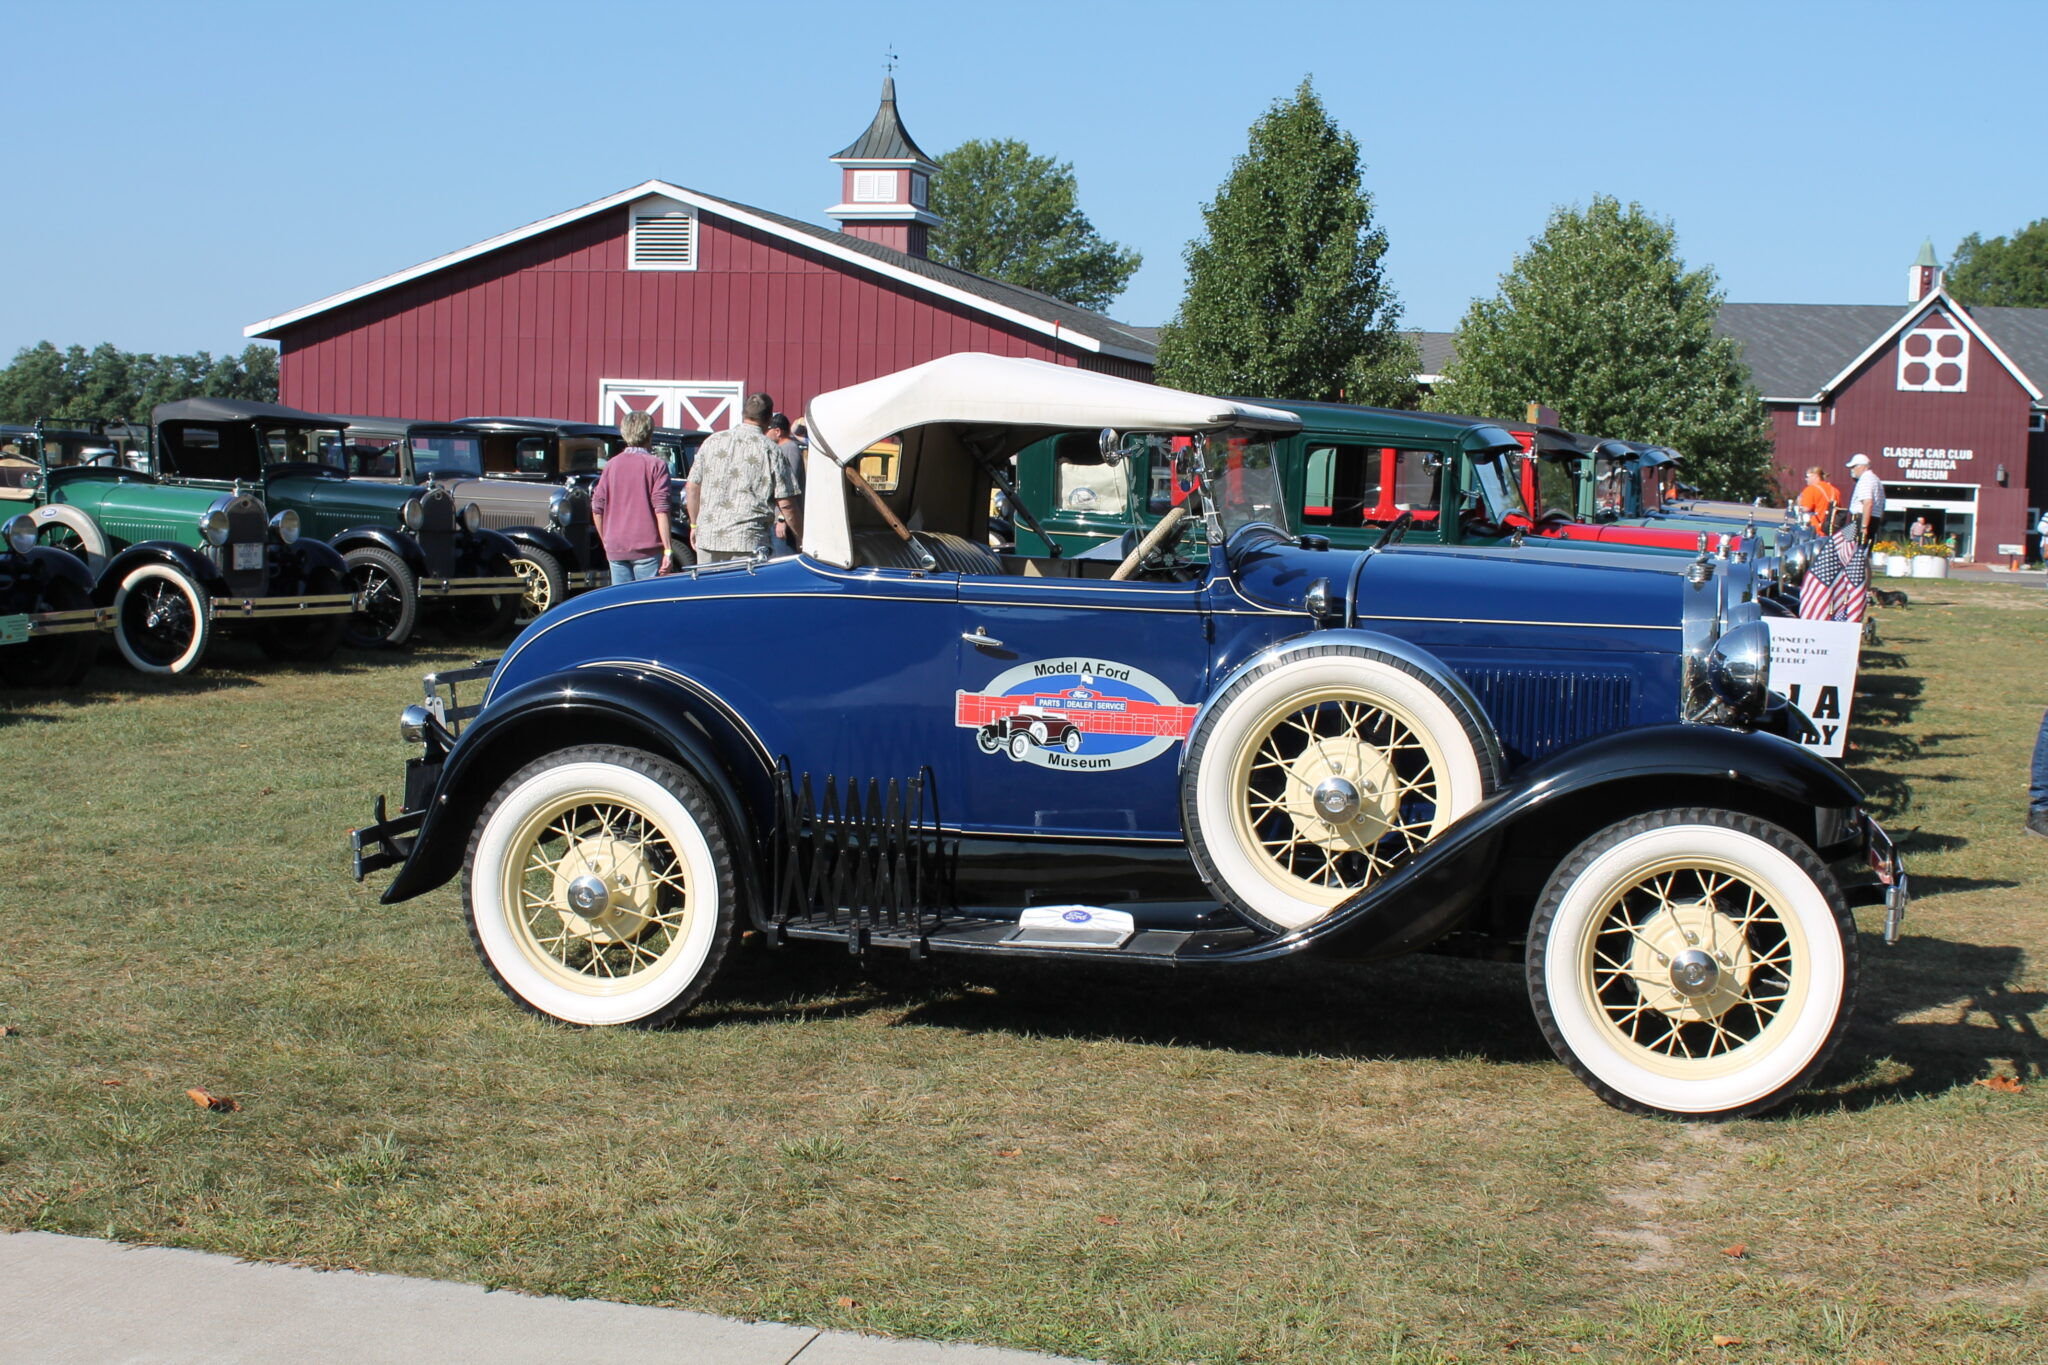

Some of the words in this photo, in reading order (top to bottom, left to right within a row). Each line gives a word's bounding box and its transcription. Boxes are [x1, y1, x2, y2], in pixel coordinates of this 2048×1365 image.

[1883, 447, 1924, 458] CLASSIC
[1926, 448, 1946, 458] CAR
[1948, 450, 1973, 460] CLUB
[1898, 458, 1912, 468] OF
[1912, 459, 1956, 470] AMERICA
[1906, 470, 1948, 480] MUSEUM
[1034, 661, 1078, 676] Model
[1082, 661, 1093, 674] A
[1096, 663, 1130, 681] Ford
[1039, 698, 1061, 708] PARTS
[1066, 700, 1093, 709] DEALER
[1096, 702, 1125, 711] SERVICE
[1048, 753, 1111, 768] Museum
